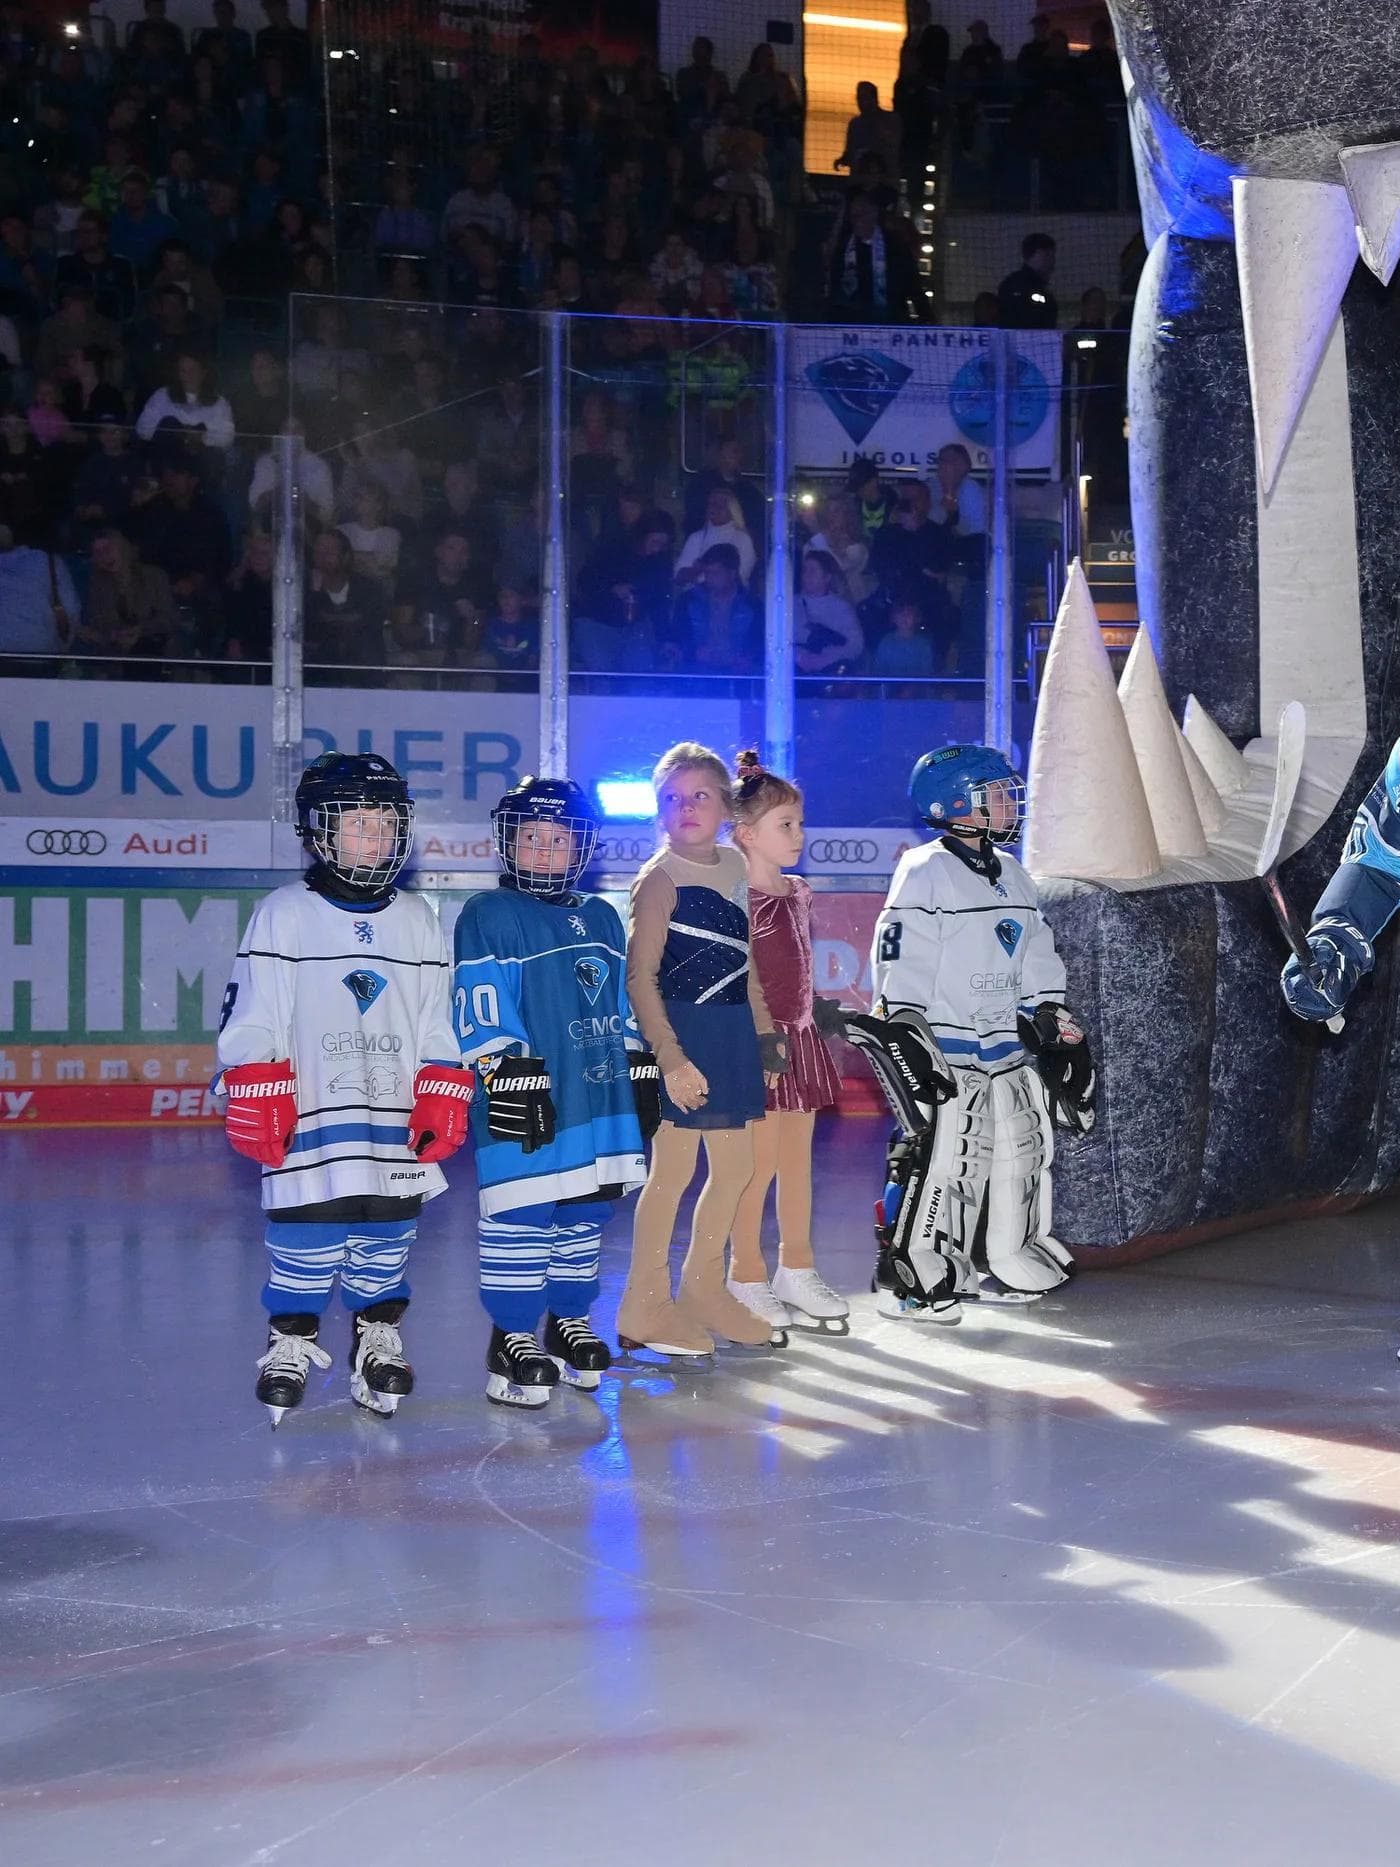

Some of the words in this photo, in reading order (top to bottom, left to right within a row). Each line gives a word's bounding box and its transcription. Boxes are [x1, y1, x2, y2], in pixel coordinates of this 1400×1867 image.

[892, 334, 989, 347] PANTHE
[123, 833, 208, 854] Audi
[424, 836, 494, 858] Aud
[0, 896, 240, 1031] HIM
[455, 984, 499, 1039] 20
[888, 1042, 921, 1092] Velocity
[390, 1170, 426, 1180] BAUER
[922, 1185, 943, 1239] VAUGHN
